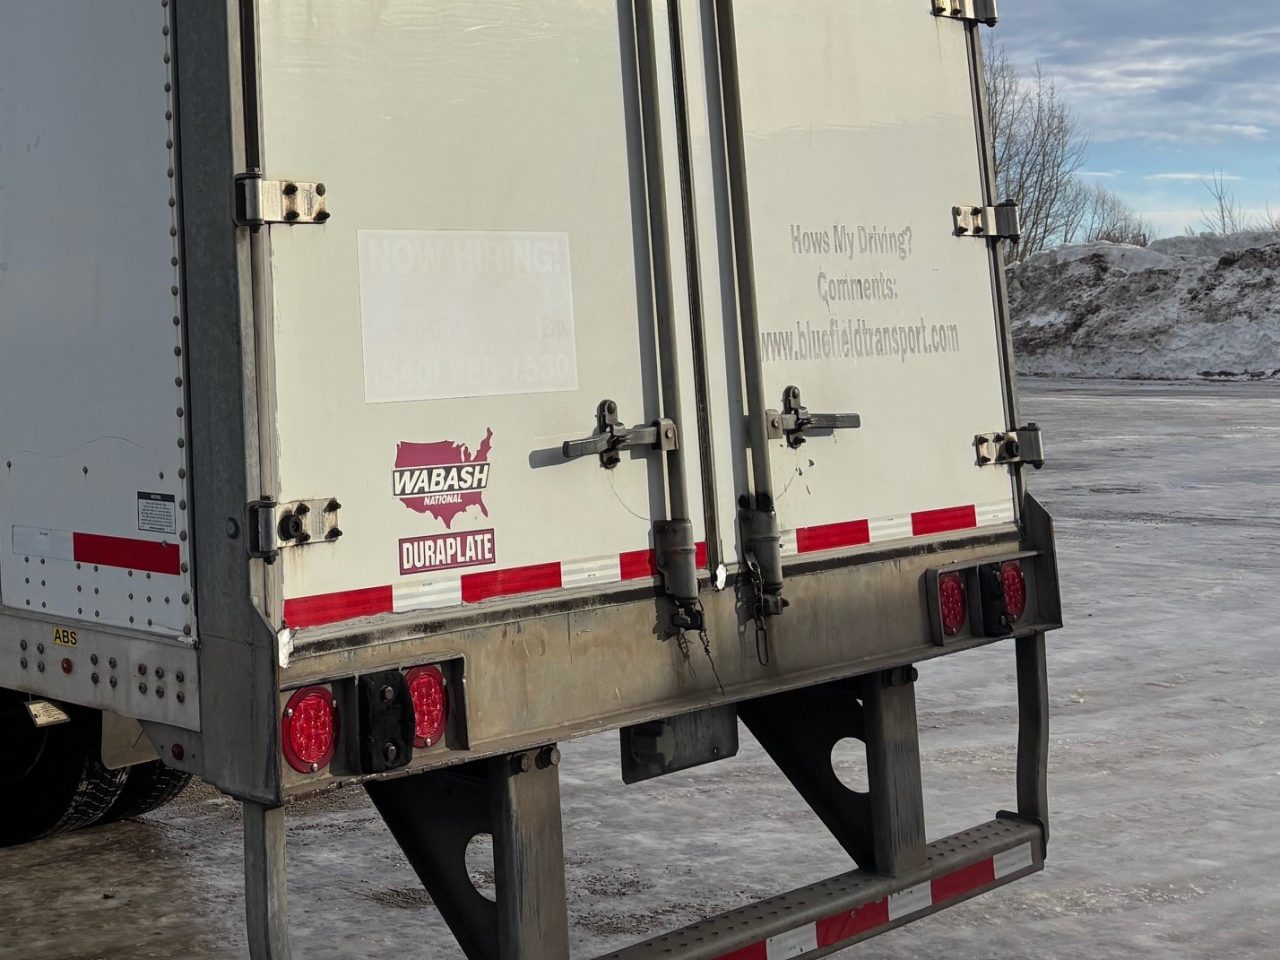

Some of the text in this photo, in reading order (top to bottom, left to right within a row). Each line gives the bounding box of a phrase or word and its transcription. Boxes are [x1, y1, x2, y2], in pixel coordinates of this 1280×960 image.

[790, 224, 913, 260] Hows My Driving?
[817, 271, 898, 302] Comments:
[760, 317, 960, 362] www.bluefieldtransport.com
[394, 464, 490, 494] WABASH
[423, 494, 462, 506] NATIONAL
[402, 533, 494, 570] DURAPLATE
[54, 628, 77, 645] ABS
